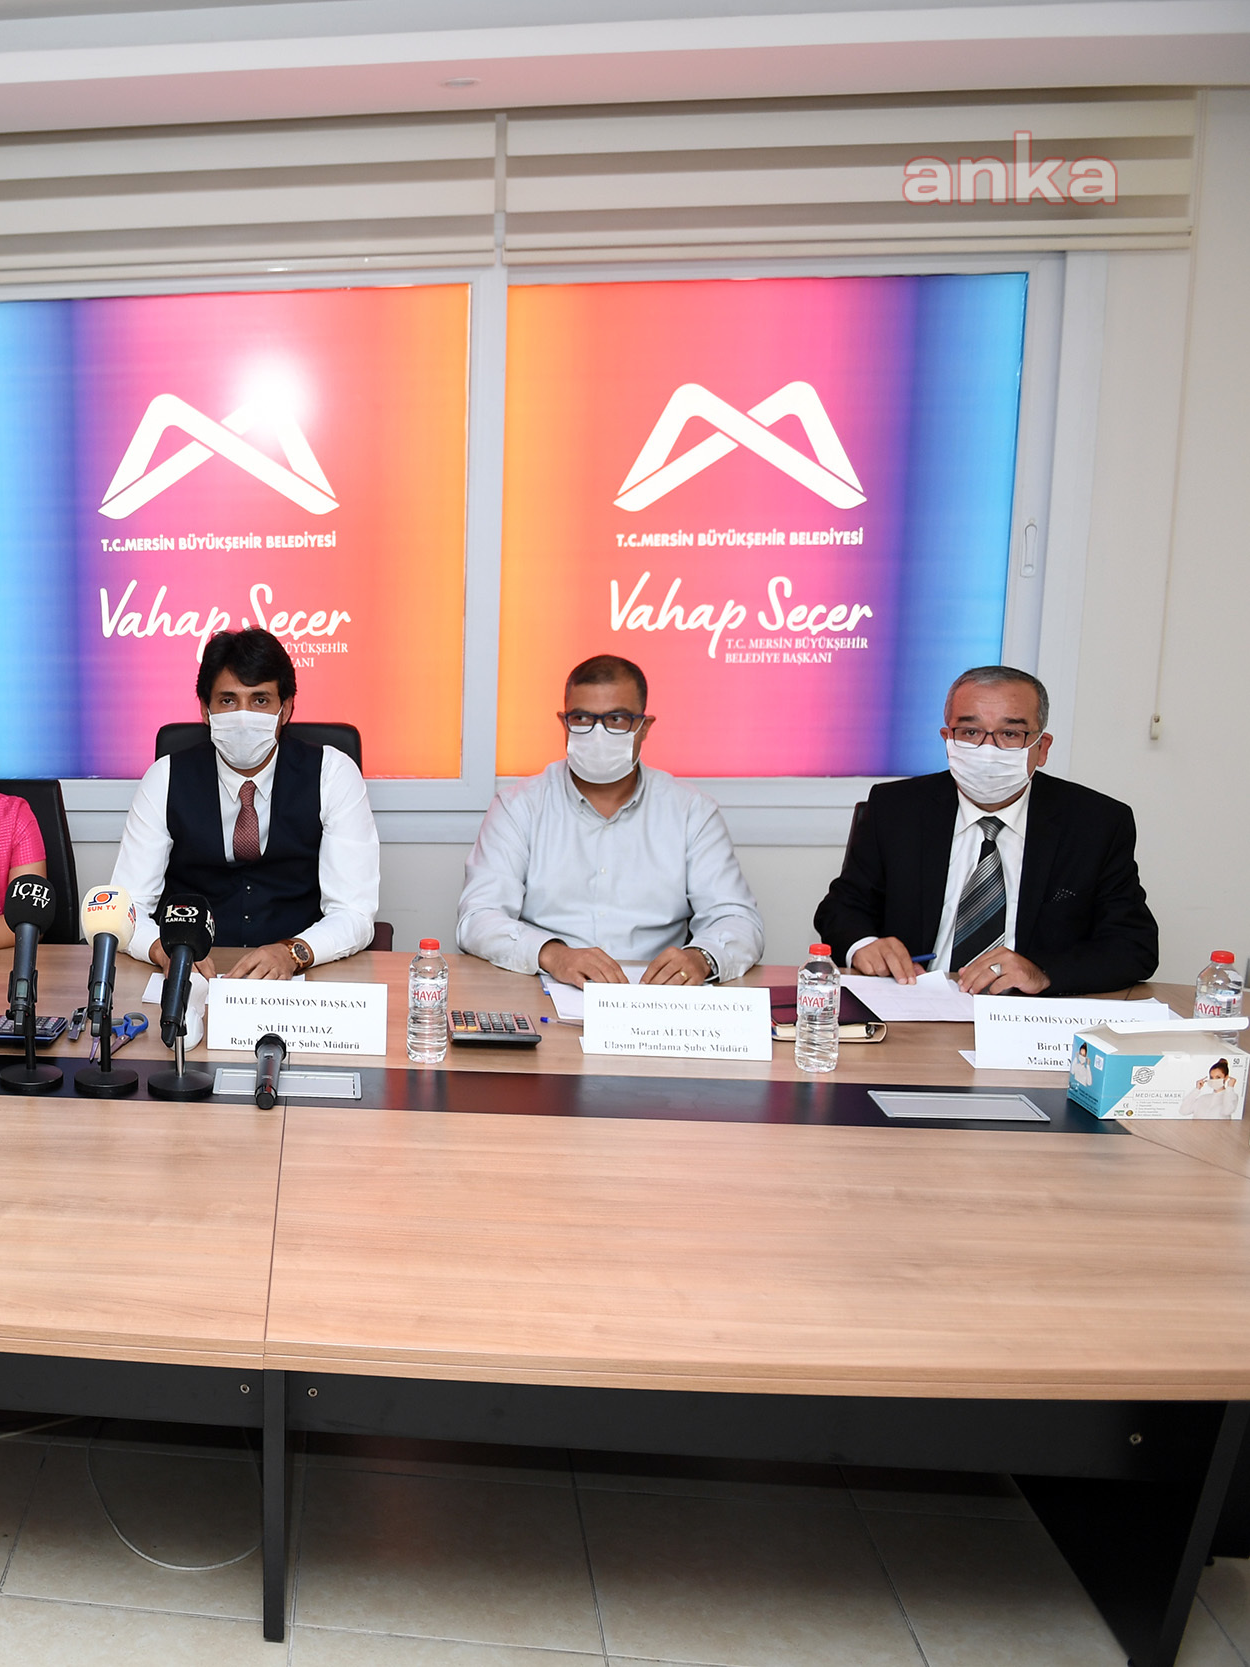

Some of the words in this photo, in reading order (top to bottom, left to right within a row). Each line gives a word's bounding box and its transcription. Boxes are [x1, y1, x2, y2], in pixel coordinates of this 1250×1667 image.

[101, 534, 175, 551] T.C.MERSİN
[179, 532, 262, 552] BÜYÜKŞEHİR
[266, 530, 337, 548] BELEDİYESİ
[616, 529, 693, 547] T.C.MERSİN
[698, 528, 785, 548] BÜYÜKŞEHİR
[790, 527, 864, 546] BELEDİYESİ
[100, 579, 231, 663] Vahap
[242, 583, 352, 640] Seçer
[610, 571, 747, 658] Vahap
[758, 576, 873, 635] Seçer
[726, 638, 746, 649] T.C.
[748, 636, 792, 649] MERSİN
[795, 635, 869, 651] BÜYÜKŞEHİR
[725, 652, 780, 664] BELEDİYE
[783, 652, 832, 666] BAŞKANI
[11, 881, 51, 900] İÇEL
[32, 896, 49, 909] TV
[225, 994, 257, 1005] İHALE
[260, 996, 317, 1007] KOMİSYON
[321, 999, 366, 1009] BAŞKANI
[413, 989, 442, 1001] HAYAT
[598, 999, 628, 1009] İHALE
[631, 1001, 690, 1011] KOMİSYONU
[694, 1003, 730, 1012] UZMAN
[733, 1002, 753, 1012] ÜYE
[989, 1012, 1021, 1022] İHALE
[1024, 1014, 1086, 1026] KOMİSYONU
[257, 1023, 288, 1032] SALİH
[291, 1025, 333, 1035] YILMAZ
[630, 1027, 659, 1036] Murat
[663, 1028, 721, 1038] ALTUNTAŞ
[231, 1037, 253, 1047] Raylı
[298, 1039, 320, 1050] Şube
[323, 1040, 360, 1050] Müdürü
[604, 1040, 636, 1051] Ulaşım
[638, 1042, 681, 1051] Planlama
[684, 1043, 707, 1053] Şube
[710, 1043, 748, 1053] Müdürü
[1037, 1042, 1061, 1051] Birol
[1027, 1056, 1064, 1067] Makine
